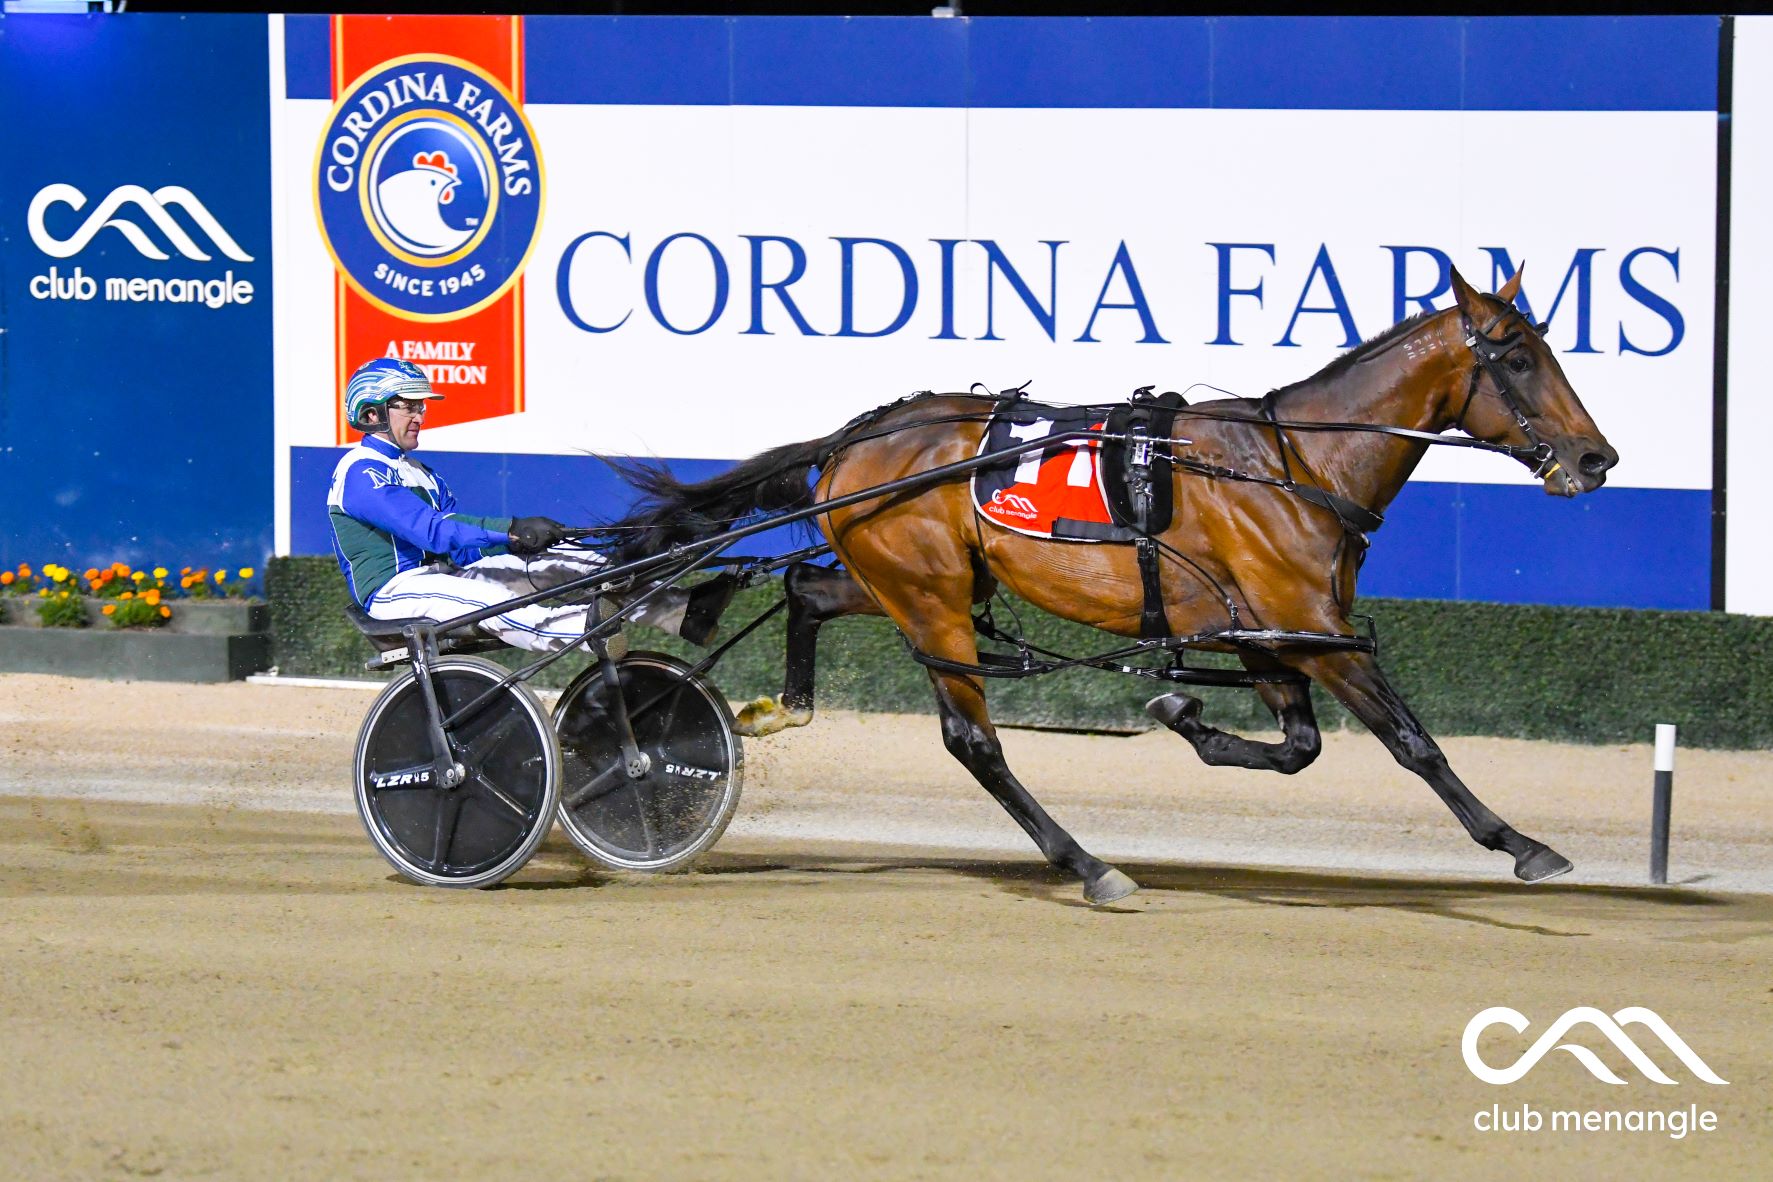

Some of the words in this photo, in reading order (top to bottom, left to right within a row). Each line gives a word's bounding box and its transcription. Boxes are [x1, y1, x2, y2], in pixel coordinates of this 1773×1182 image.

[327, 72, 450, 192] CORDINA
[453, 81, 532, 197] FARMS
[30, 266, 97, 301] club
[105, 270, 254, 309] menangle
[374, 263, 434, 297] SINCE
[439, 264, 486, 295] 1945
[555, 231, 1171, 346] CORDINA
[1204, 242, 1686, 358] FARMS
[385, 340, 402, 358] A
[403, 341, 476, 361] FAMILY
[988, 506, 1005, 515] club
